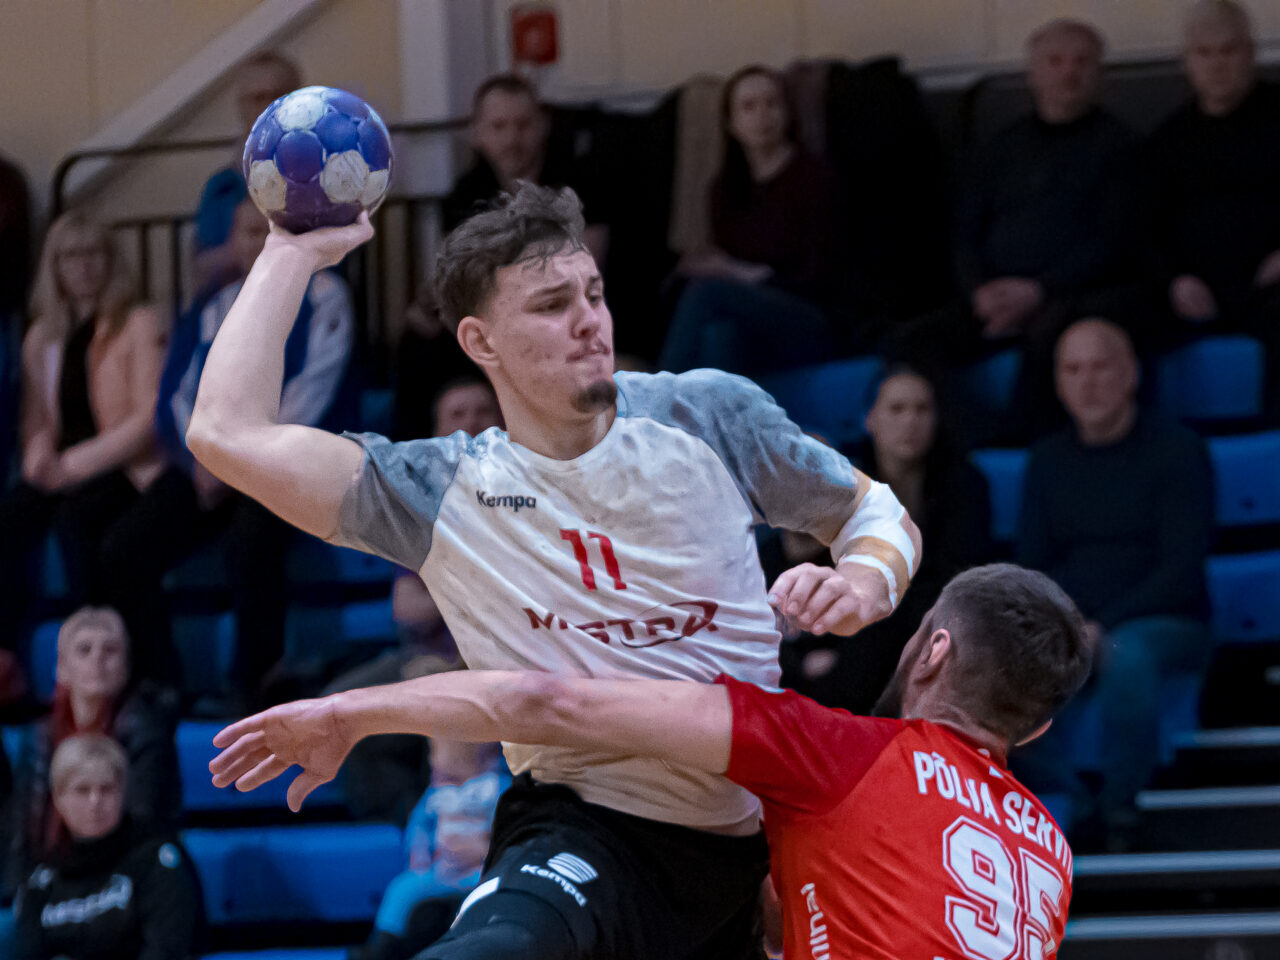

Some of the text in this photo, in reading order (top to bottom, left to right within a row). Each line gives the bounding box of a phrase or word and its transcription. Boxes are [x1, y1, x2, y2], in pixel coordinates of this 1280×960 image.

[476, 490, 537, 512] Kempa
[559, 528, 627, 591] 11
[520, 864, 587, 906] Kempa
